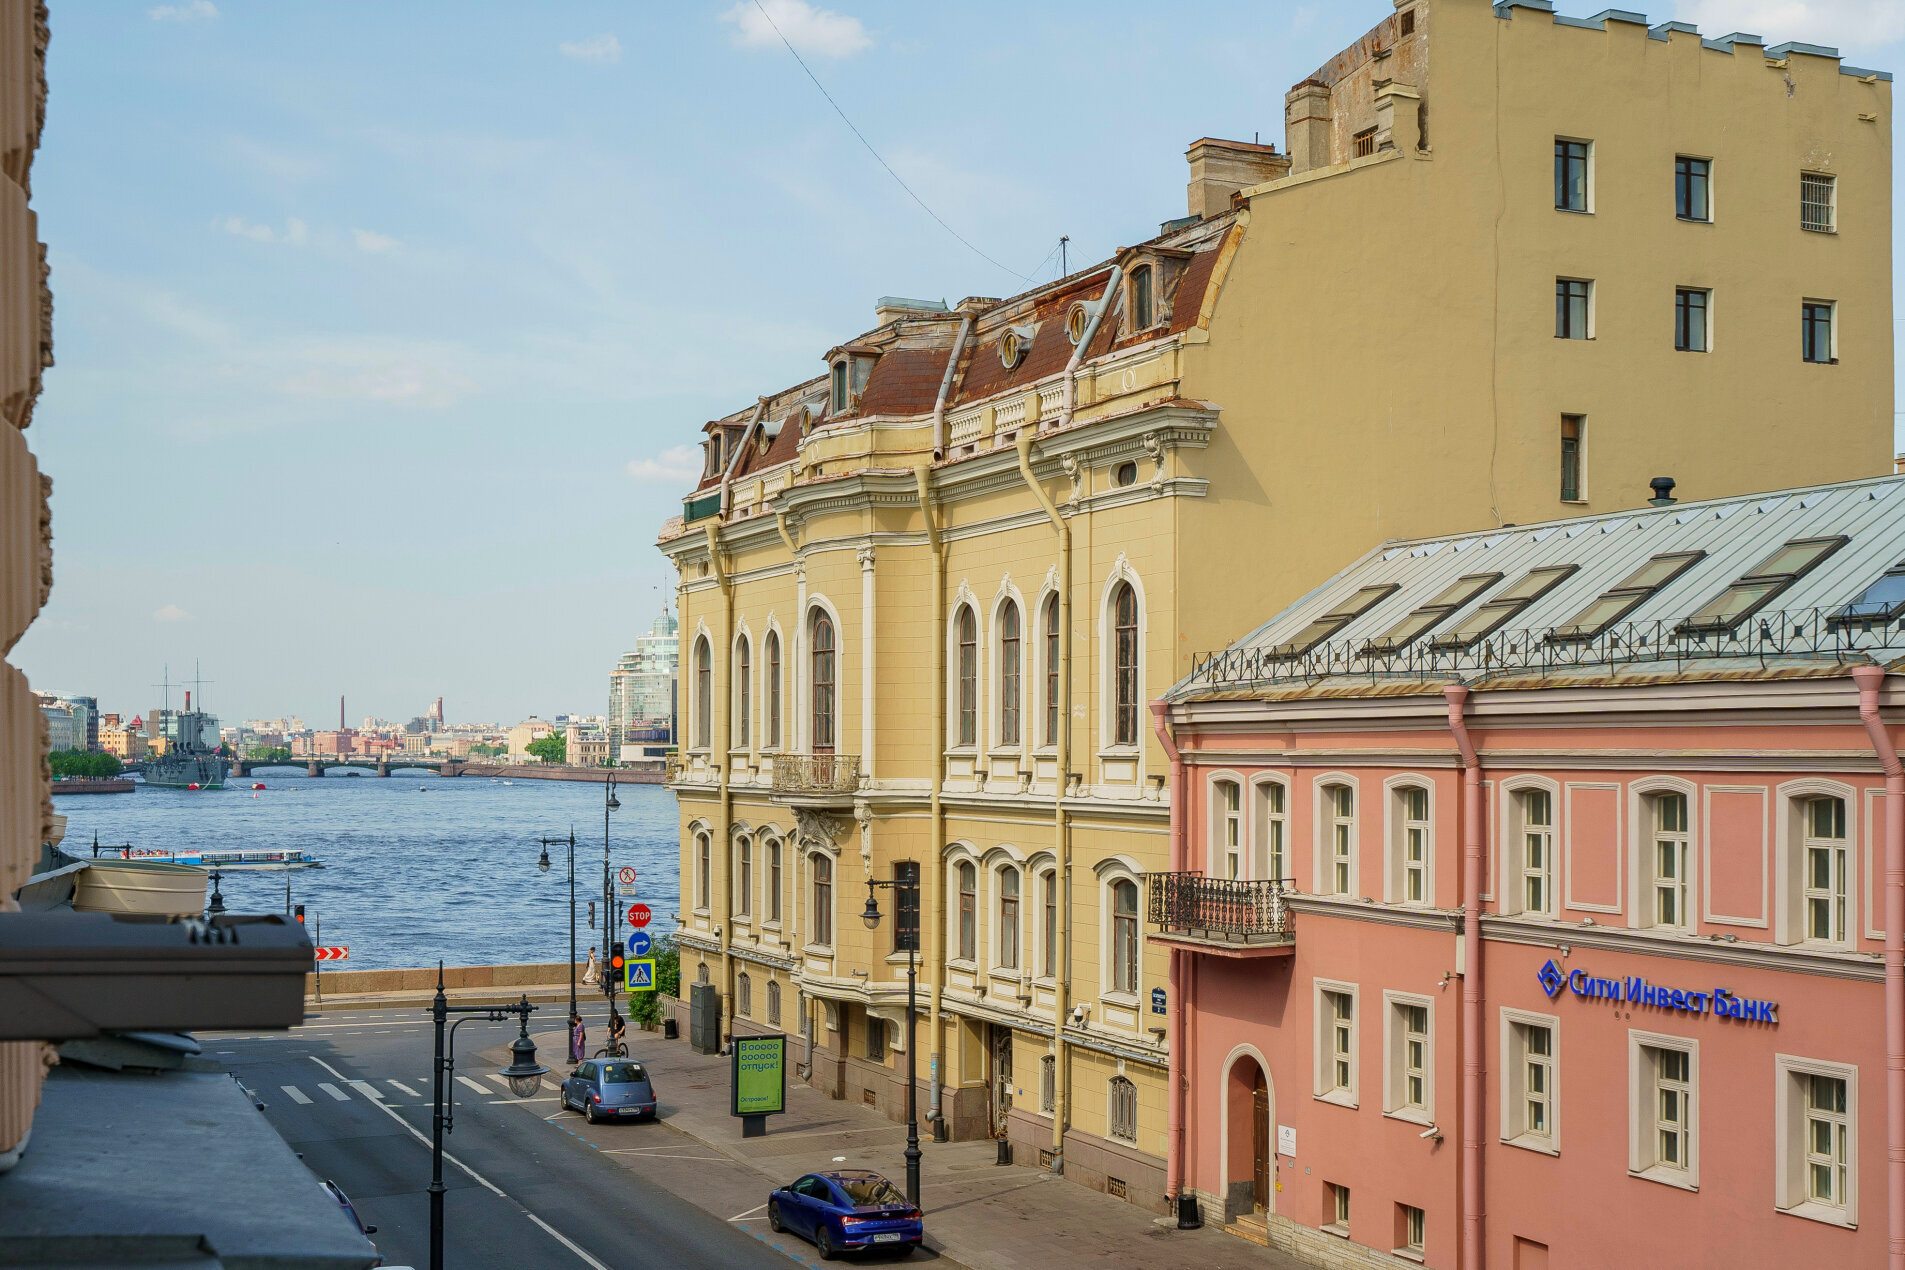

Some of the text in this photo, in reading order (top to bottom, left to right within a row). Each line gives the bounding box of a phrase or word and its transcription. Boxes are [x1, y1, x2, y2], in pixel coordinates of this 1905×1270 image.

[629, 912, 650, 921] STOP
[1569, 969, 1775, 1023] Сити Инвест Банк
[741, 1043, 747, 1052] В
[741, 1061, 778, 1072] отпуск!
